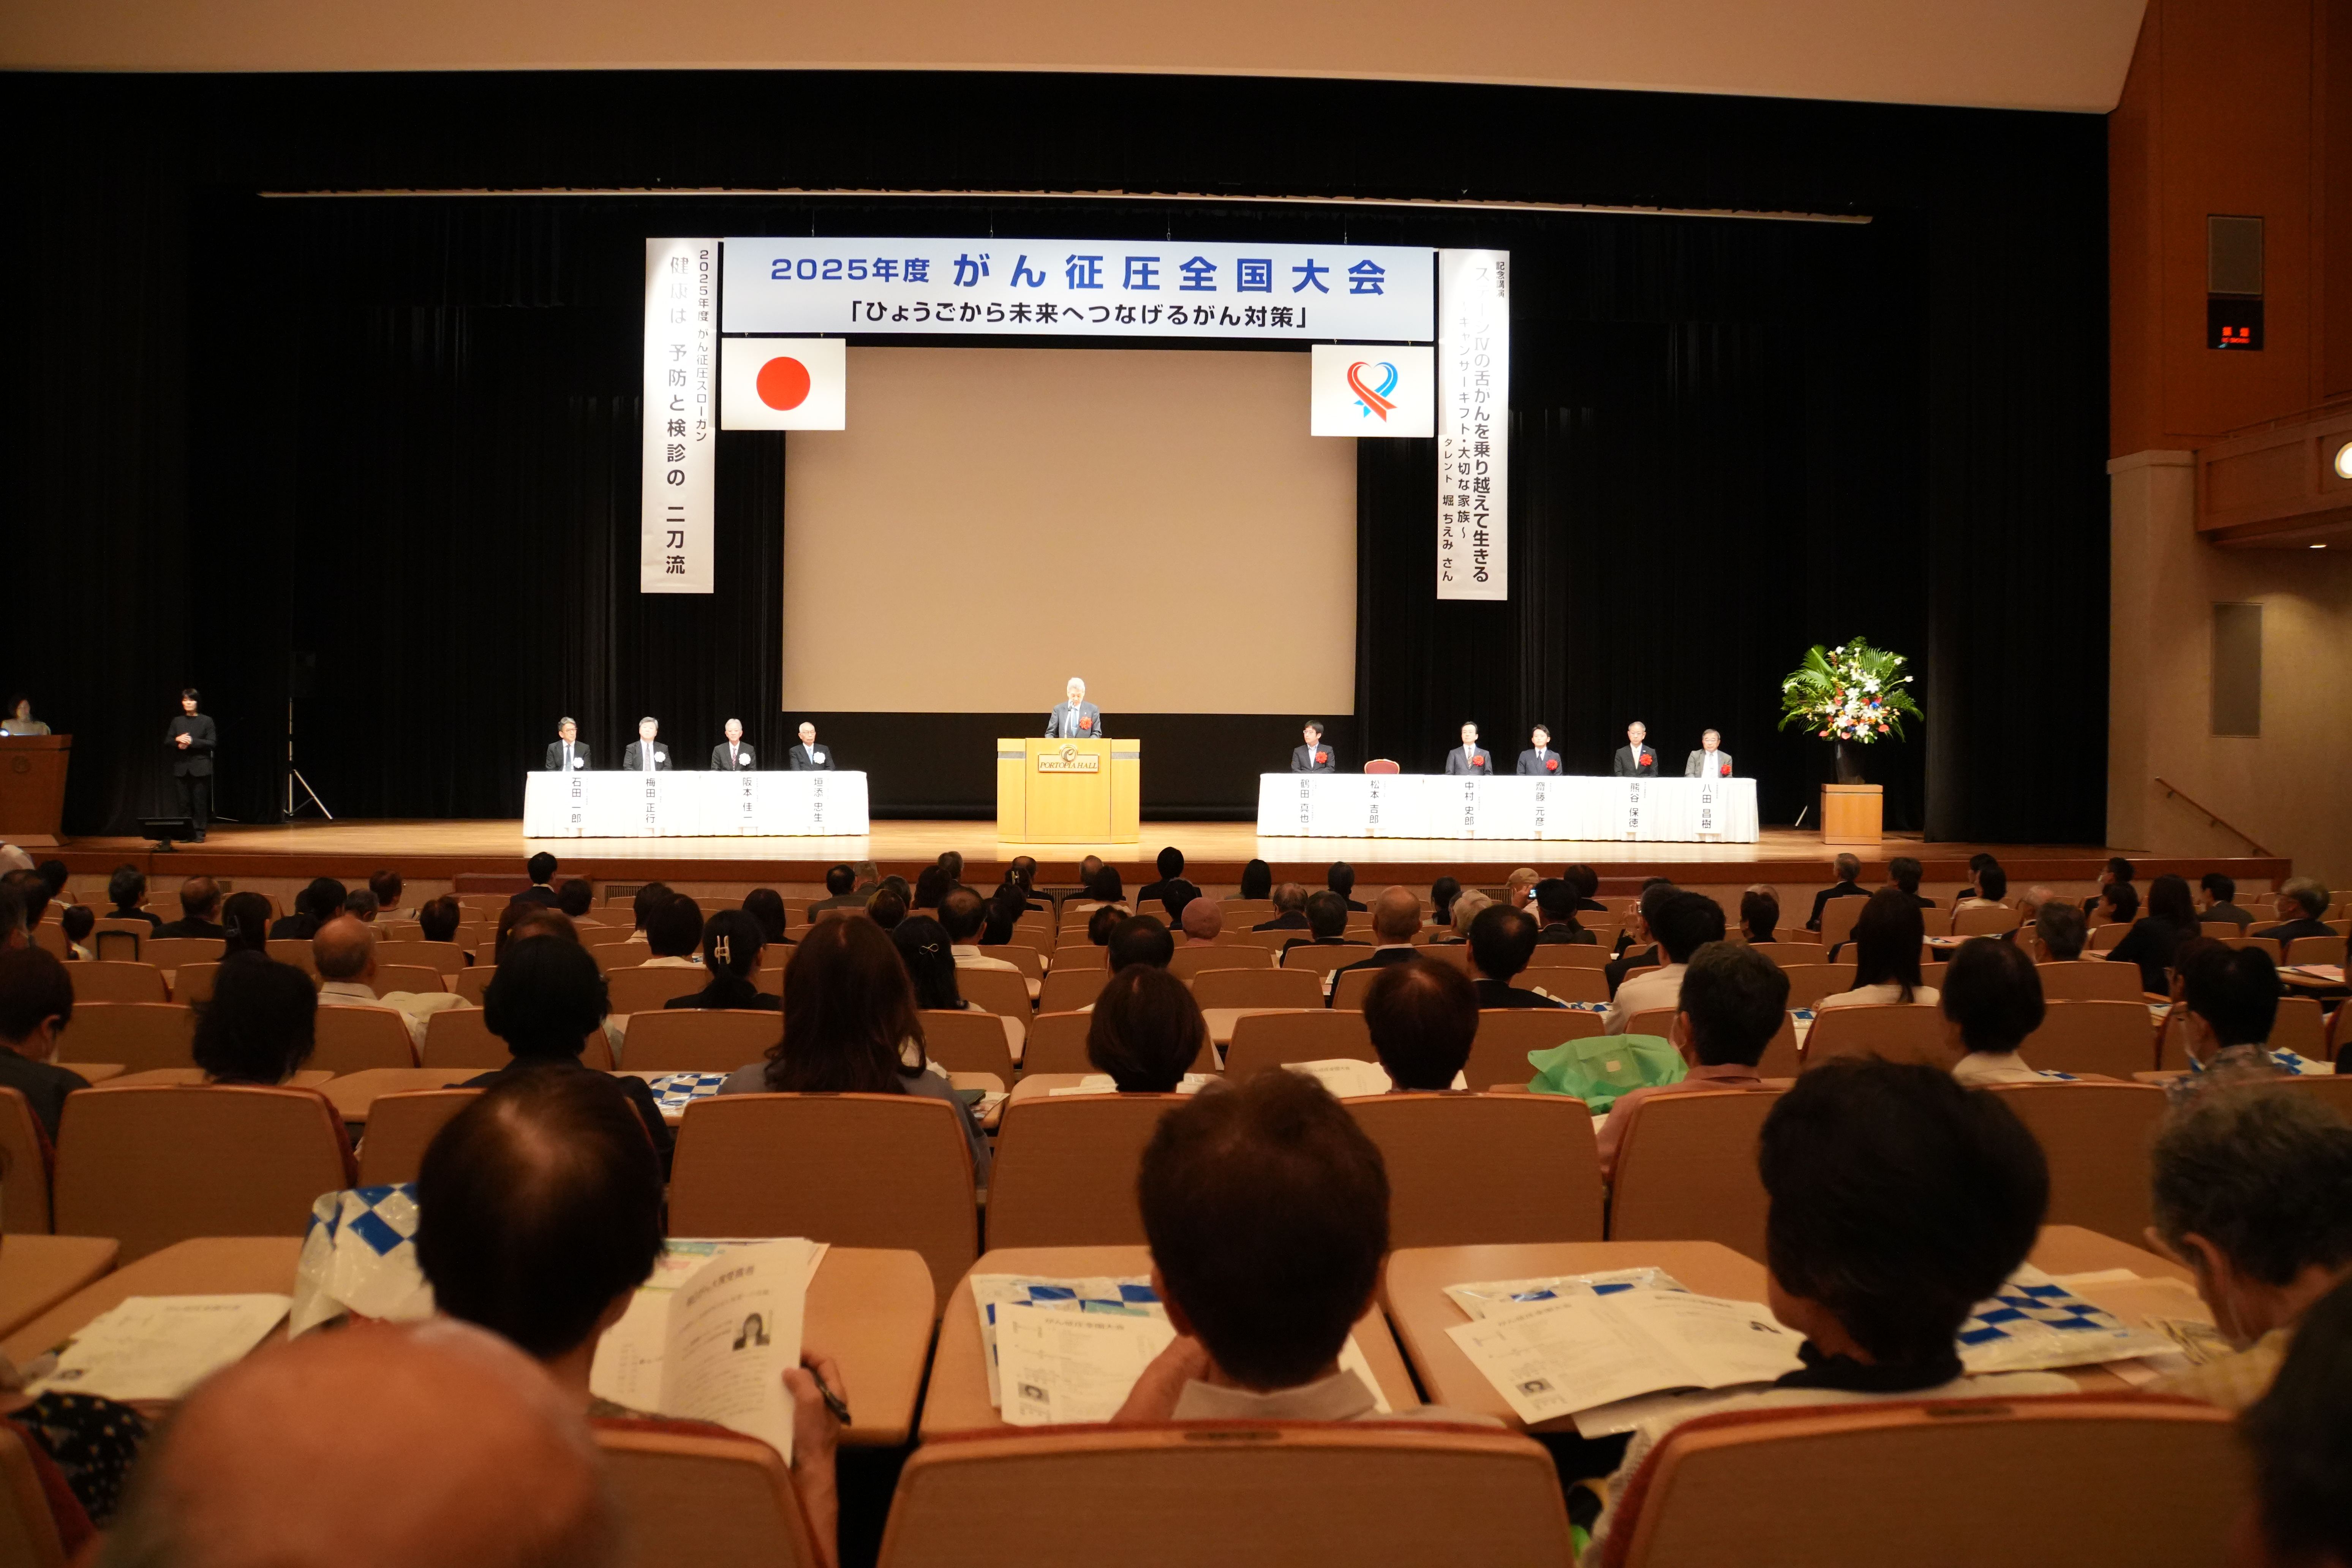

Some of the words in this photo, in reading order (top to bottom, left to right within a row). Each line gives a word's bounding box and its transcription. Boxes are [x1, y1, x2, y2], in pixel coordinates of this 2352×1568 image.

[772, 258, 930, 283] 2025年度
[954, 253, 1386, 296] がん征圧全国大会
[1496, 262, 1505, 298] 記念講演
[671, 257, 689, 324] 健康は
[699, 250, 709, 322] 2025年度
[853, 301, 1306, 329] 「ひょうごから未来へつなげるがん対策」
[697, 330, 708, 442] がん征圧スローガン
[667, 345, 687, 486] 予防と検診の
[666, 507, 686, 575] 二刀流
[1443, 514, 1453, 550] ちえみ
[1443, 558, 1453, 582] さん
[572, 778, 581, 797] 石田
[646, 778, 656, 798] 梅田
[743, 778, 752, 797] 阪本
[1370, 780, 1380, 799] 松本
[1465, 781, 1474, 801] 中村
[1702, 784, 1712, 803] 八田
[572, 807, 581, 823] 一郎
[646, 803, 656, 823] 正行
[743, 803, 752, 818] 佳一
[814, 803, 823, 822] 忠生
[1370, 805, 1379, 824] 吉郎
[1465, 806, 1474, 825] 史郎
[1536, 807, 1545, 826] 元彦
